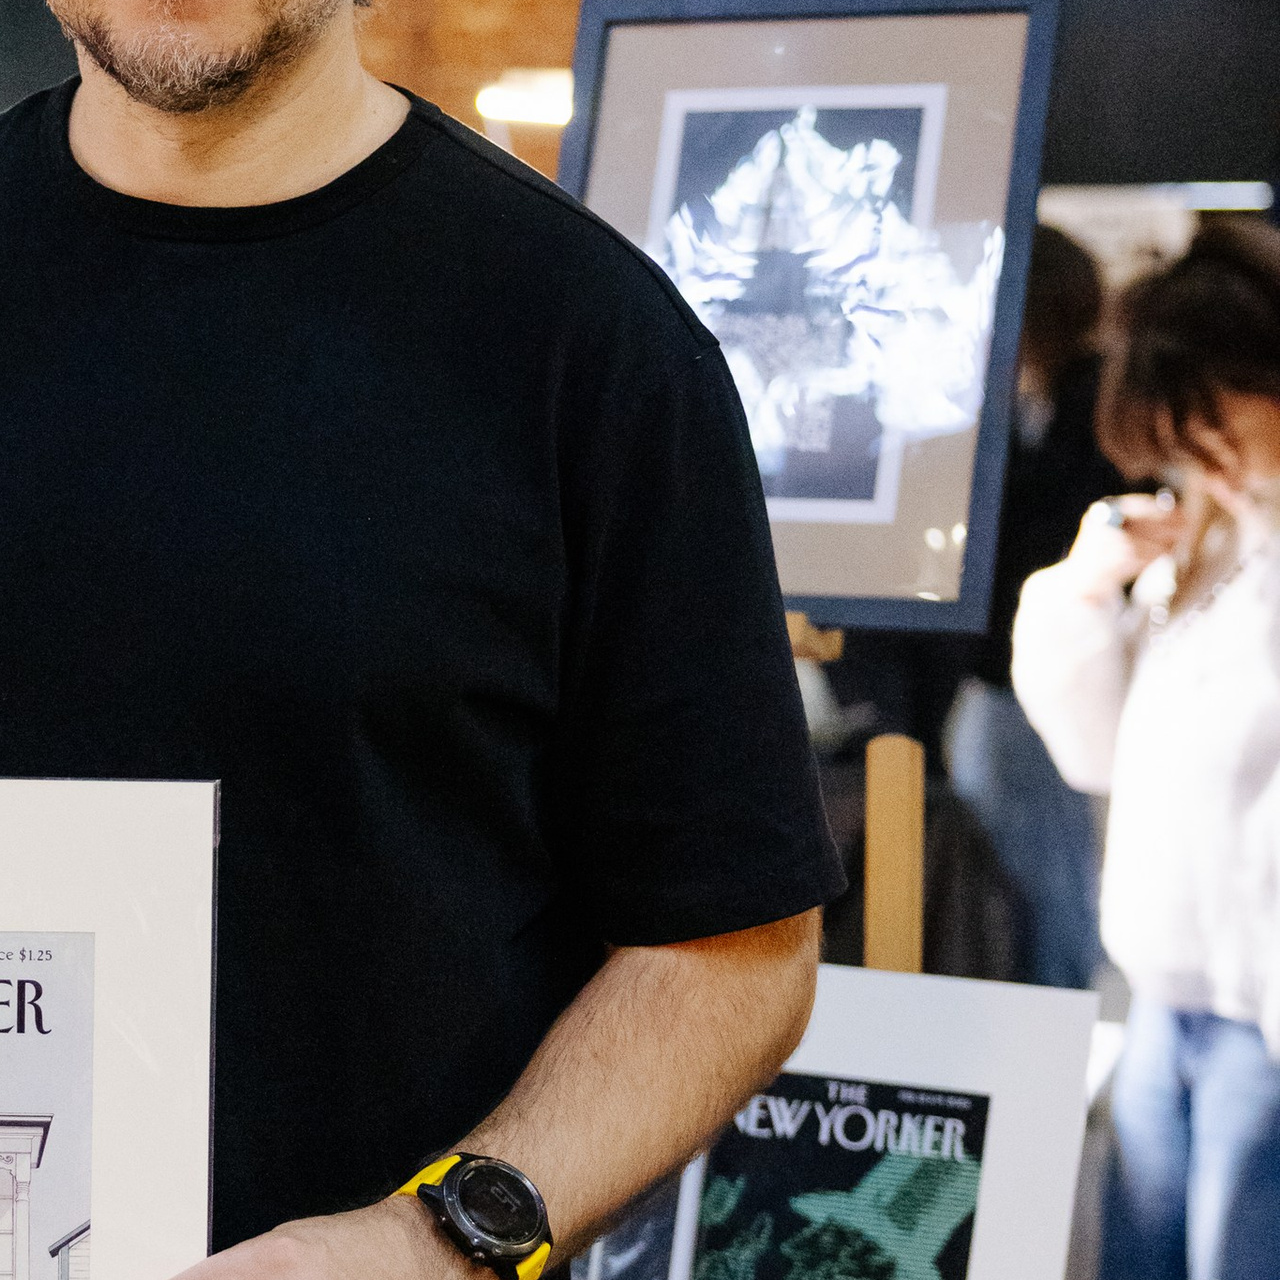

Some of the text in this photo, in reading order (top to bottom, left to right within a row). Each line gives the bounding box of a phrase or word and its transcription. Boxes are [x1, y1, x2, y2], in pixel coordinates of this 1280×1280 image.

[19, 946, 53, 962] $1.25
[827, 1081, 869, 1104] THE
[814, 1103, 966, 1161] YORKER
